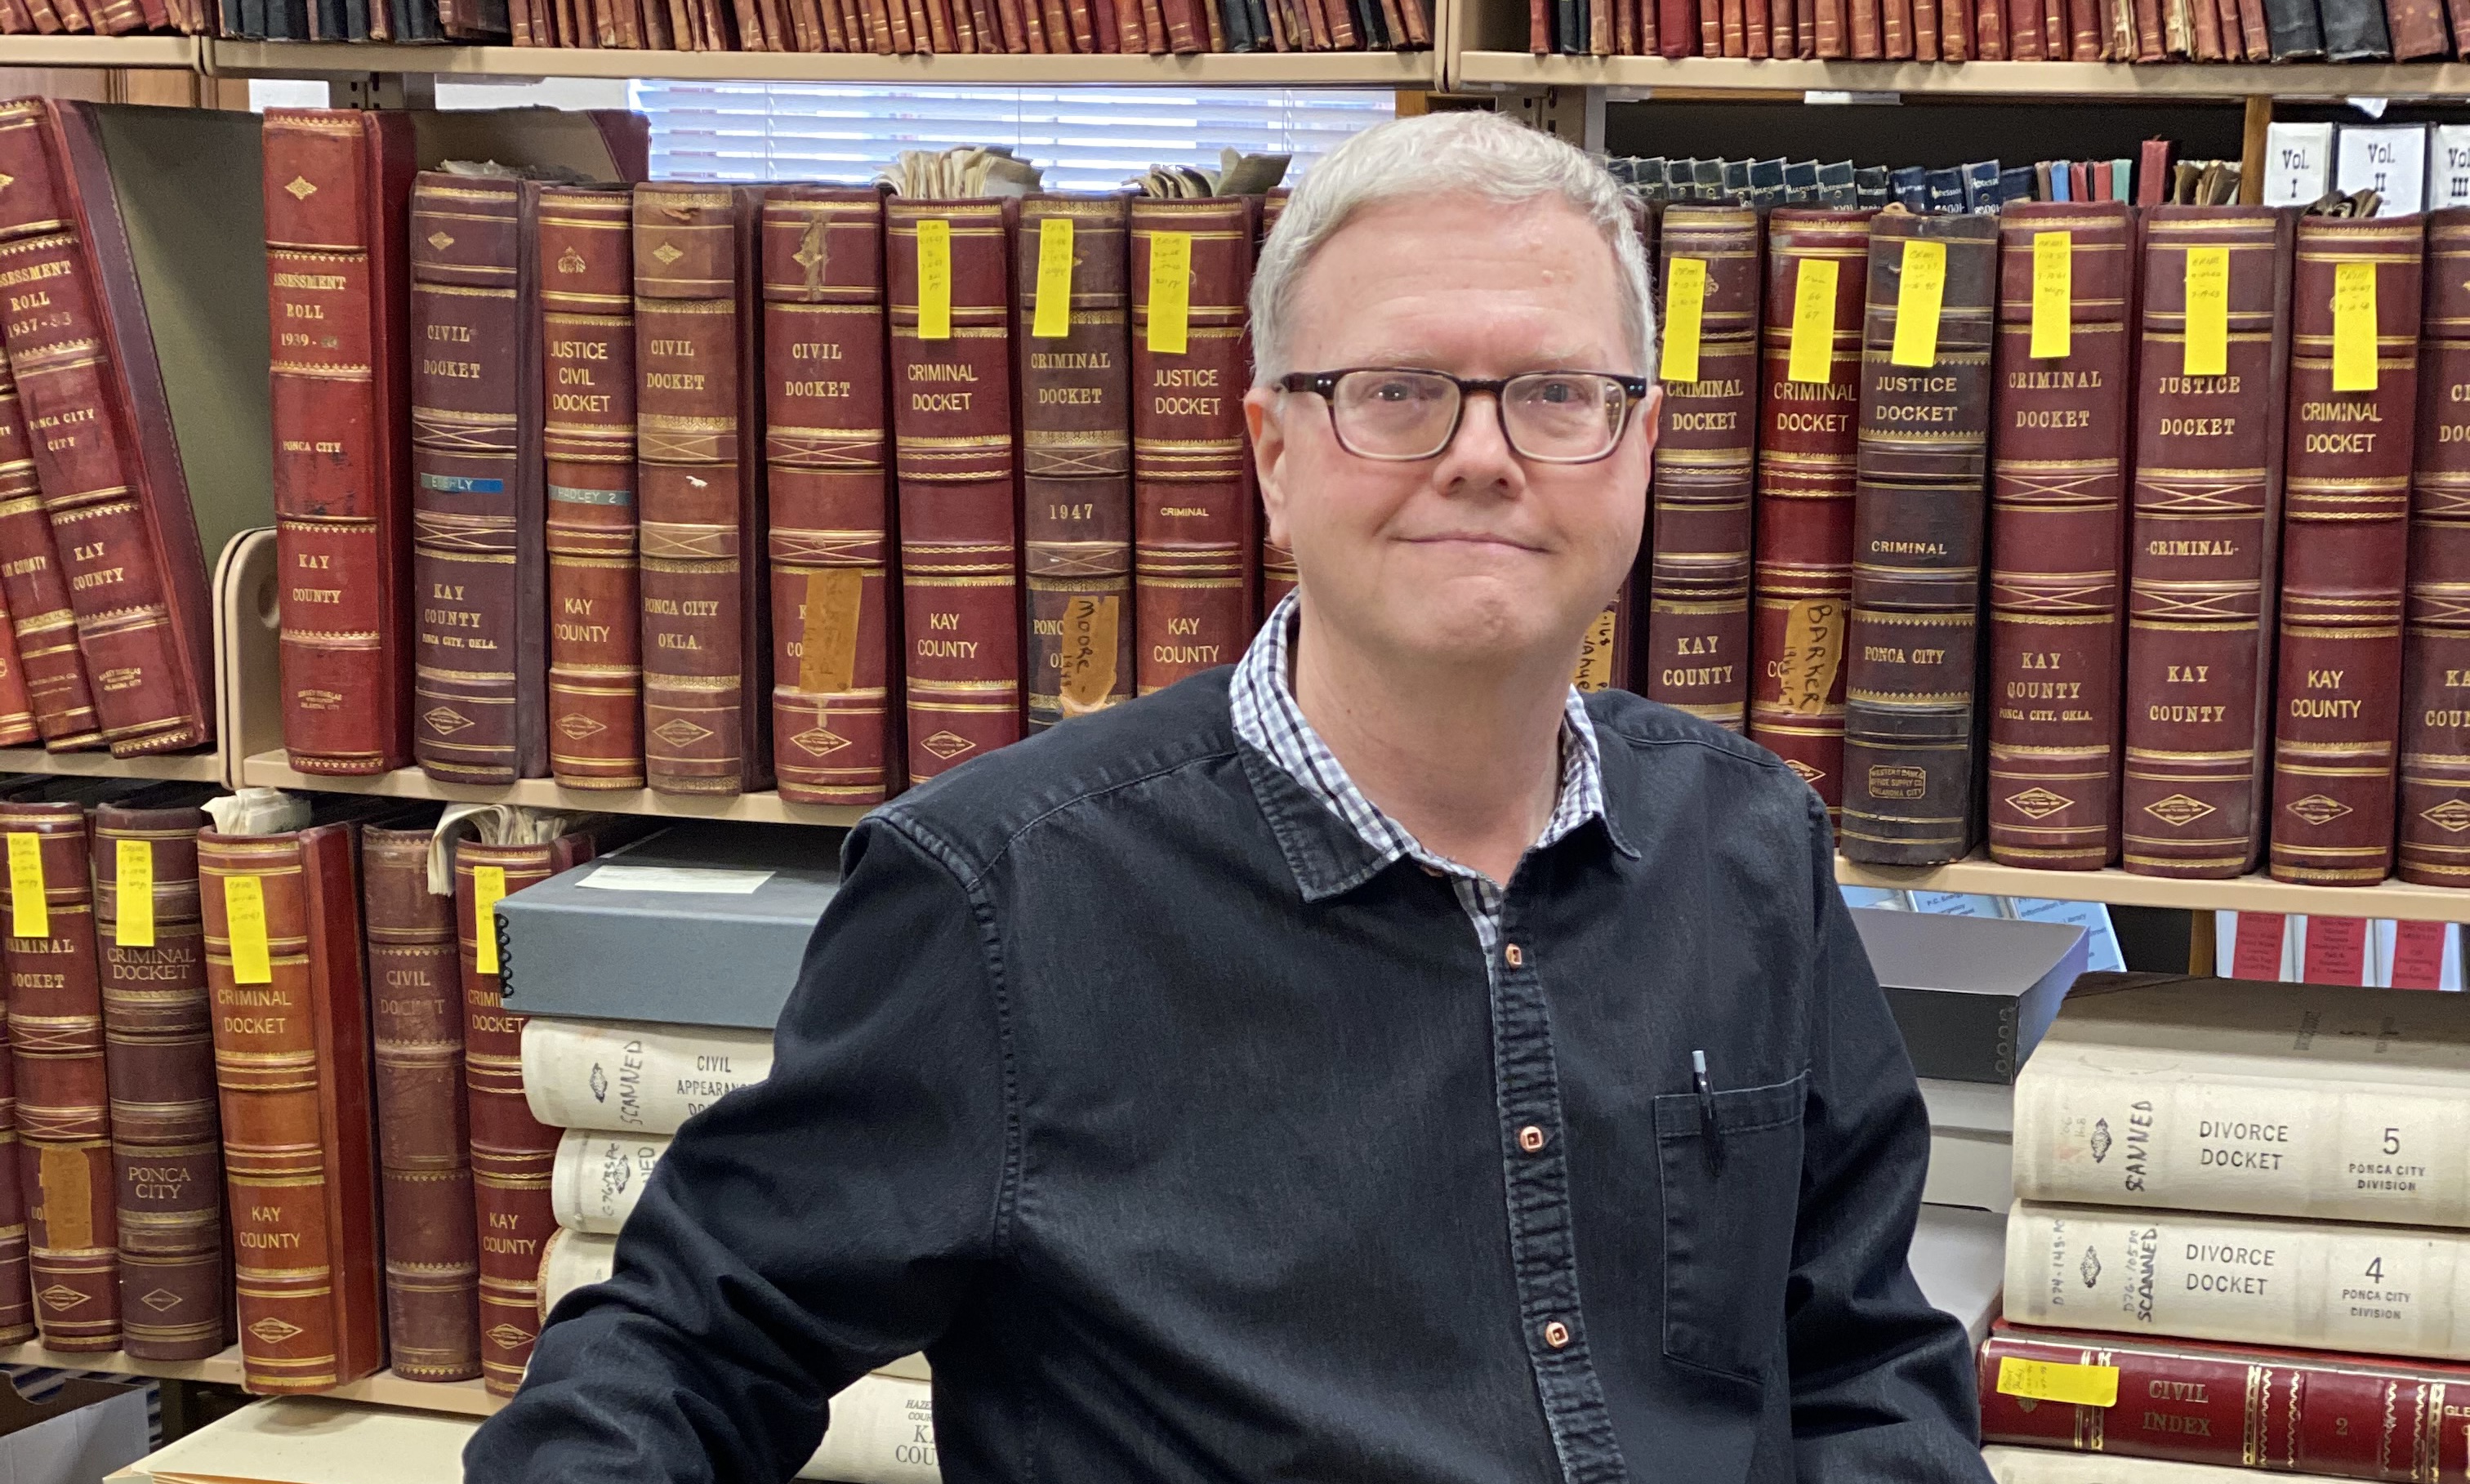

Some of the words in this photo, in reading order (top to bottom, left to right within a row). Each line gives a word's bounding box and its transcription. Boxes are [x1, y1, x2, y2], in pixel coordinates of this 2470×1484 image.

[2282, 149, 2309, 169] Vol.
[2368, 144, 2395, 163] Vol.
[0, 261, 71, 286] SESSMENT
[11, 292, 50, 311] ROLL
[286, 303, 324, 319] ROLL
[427, 325, 471, 342] CIVIL
[551, 341, 608, 359] JUSTICE
[651, 340, 694, 357] CIVIL
[792, 343, 842, 359] CIVIL
[424, 360, 480, 378] DOCKET
[1031, 353, 1111, 368] CRIMINAL
[560, 368, 595, 386] CIVIL
[647, 373, 705, 390] DOCKET
[907, 364, 979, 381] CRIMINAL
[1153, 369, 1219, 386] JUSTICE
[2009, 370, 2102, 390] CRIMINAL
[786, 381, 850, 397] DOCKET
[1666, 379, 1743, 398] CRIMINAL
[1774, 381, 1857, 401] CRIMINAL
[1875, 377, 1958, 394] JUSTICE
[2159, 376, 2240, 394] JUSTICE
[553, 394, 611, 412] DOCKET
[912, 393, 973, 412] DOCKET
[1039, 388, 1102, 404] DOCKET
[64, 408, 95, 422] CITY
[1155, 398, 1221, 416] DOCKET
[1875, 405, 1958, 422] DOCKET
[2302, 403, 2383, 422] CRIMINAL
[1673, 412, 1737, 430] DOCKET
[1777, 413, 1848, 432] DOCKET
[2016, 410, 2090, 428] DOCKET
[2160, 418, 2236, 436] DOCKET
[47, 436, 75, 452] CITY
[316, 442, 341, 452] CITY
[2307, 434, 2376, 454] DOCKET
[609, 493, 616, 503] 2
[1050, 503, 1093, 519] 1947
[1160, 507, 1210, 517] CRIMINAL
[74, 541, 105, 561] KAY
[1871, 540, 1948, 555] CRIMINAL
[298, 554, 329, 569] KAY
[74, 568, 123, 590] COUNTY
[292, 588, 341, 604] COUNTY
[434, 583, 464, 601] KAY
[564, 598, 593, 615] KAY
[644, 597, 679, 617] PONCA
[683, 600, 720, 617] CITY
[425, 609, 481, 628] COUNTY
[930, 613, 960, 630] KAY
[1033, 619, 1063, 635] PONC
[1168, 617, 1200, 635] KAY
[555, 626, 610, 643] COUNTY
[658, 634, 702, 650] OKLA.
[917, 640, 979, 658] COUNTY
[1153, 645, 1219, 664] COUNTY
[1678, 635, 1719, 656] KAY
[1865, 646, 1906, 664] PONCA
[1912, 649, 1946, 665] CITY
[2021, 652, 2062, 670] KAY
[1662, 666, 1733, 687] COUNTY
[2167, 666, 2209, 682] KAY
[2307, 671, 2343, 689] KAY
[2445, 670, 2470, 686] KA
[2007, 681, 2081, 699] COUNTY
[2062, 710, 2093, 721] OKLA.
[2150, 706, 2226, 722] COUNTY
[2291, 699, 2361, 718] COUNTY
[107, 947, 196, 964] CRIMINAL
[114, 964, 190, 980] DOCKET
[386, 970, 430, 987] CIVIL
[218, 989, 292, 1006] CRIMINAL
[468, 989, 502, 1008] CRIMI
[224, 1018, 287, 1034] DOCKET
[472, 1014, 524, 1033] DOCKET
[697, 1055, 732, 1072] CIVIL
[621, 1040, 644, 1125] SCANNED
[2200, 1121, 2288, 1142] DIVORCE
[2383, 1128, 2400, 1155] 5
[2200, 1148, 2283, 1171] DOCKET
[128, 1167, 191, 1182] PONCA
[2349, 1163, 2392, 1175] PONCA
[2396, 1165, 2425, 1176] CITY
[136, 1184, 181, 1199] CITY
[2357, 1179, 2416, 1192] DIVISION
[252, 1206, 282, 1222] KAY
[489, 1212, 519, 1230] KAY
[239, 1232, 301, 1250] COUNTY
[483, 1236, 537, 1255] COUNTY
[2187, 1243, 2275, 1267] DIVORCE
[2138, 1228, 2158, 1322] SCANNED
[2365, 1257, 2384, 1283] 4
[2187, 1273, 2267, 1295] DOCKET
[2342, 1290, 2382, 1301] PONCA
[2385, 1291, 2410, 1303] CITY
[2351, 1308, 2401, 1320] DIVISION
[2149, 1379, 2209, 1403] CIVIL
[2142, 1411, 2210, 1437] INDEX
[2336, 1418, 2347, 1436] 2
